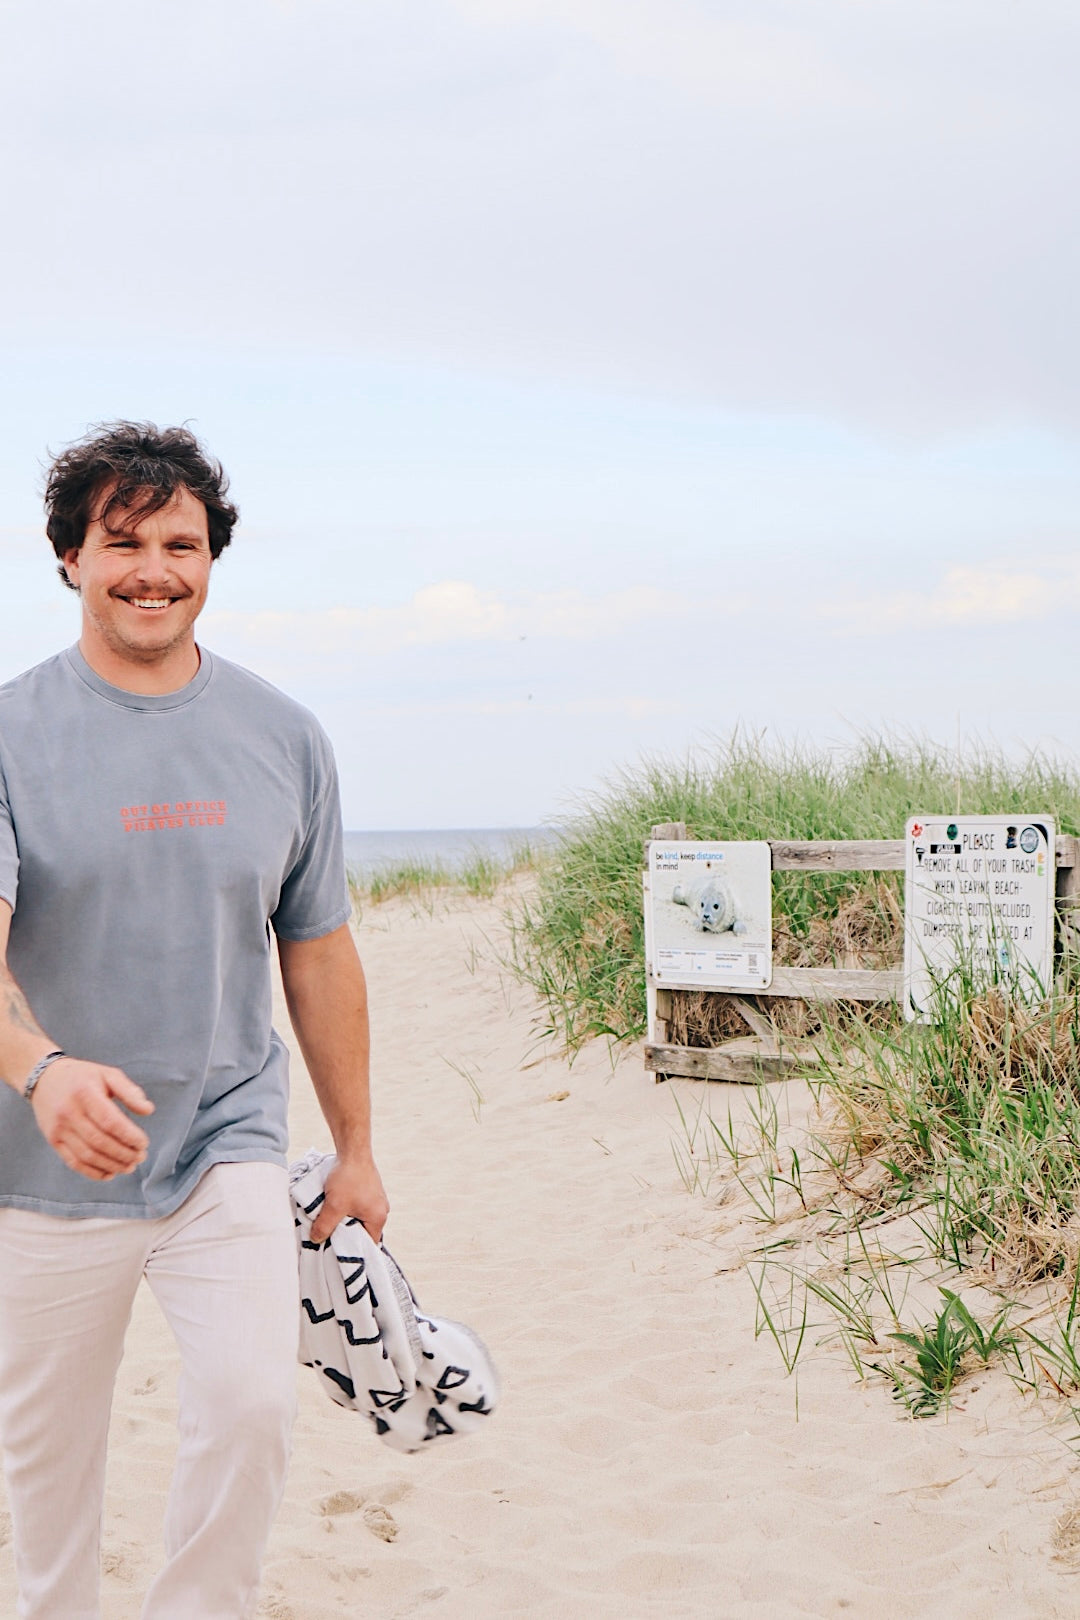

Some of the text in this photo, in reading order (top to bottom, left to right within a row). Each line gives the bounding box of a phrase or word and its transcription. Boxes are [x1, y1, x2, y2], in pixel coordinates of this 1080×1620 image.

[120, 800, 227, 817] OUT OF OFFICE
[124, 815, 225, 832] PILATES CLUB
[963, 833, 996, 851] PLEASE
[656, 852, 663, 860] be
[680, 852, 696, 862] keep
[696, 852, 724, 860] distance
[924, 858, 1036, 874] REMOVE ALL OF YOUR TRASH
[935, 880, 955, 894] WHEN
[960, 880, 989, 895] LEAVING
[1023, 926, 1033, 941] AT
